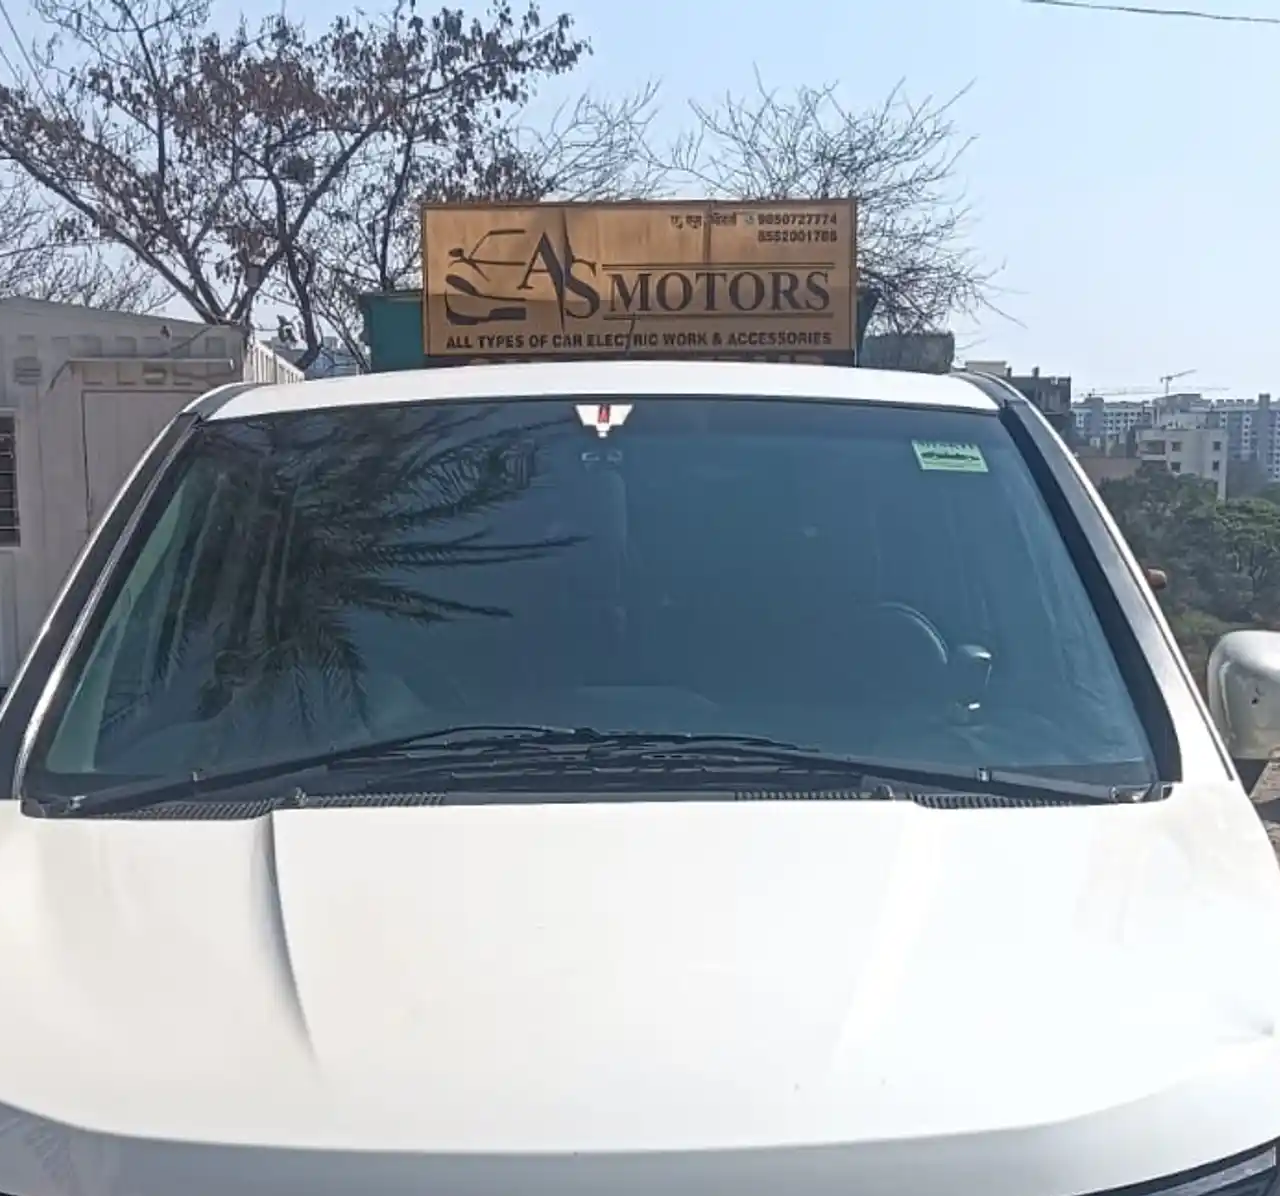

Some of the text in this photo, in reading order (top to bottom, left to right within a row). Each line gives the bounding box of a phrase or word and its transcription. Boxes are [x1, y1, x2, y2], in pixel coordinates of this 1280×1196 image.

[517, 231, 831, 333] AS MOTORS
[446, 335, 472, 349] ALL
[478, 335, 524, 348] TYPES
[529, 335, 549, 348] OF
[552, 334, 582, 347] CAR
[663, 333, 707, 346] WORK
[712, 333, 722, 346] &
[728, 332, 832, 346] ACCESSORIES
